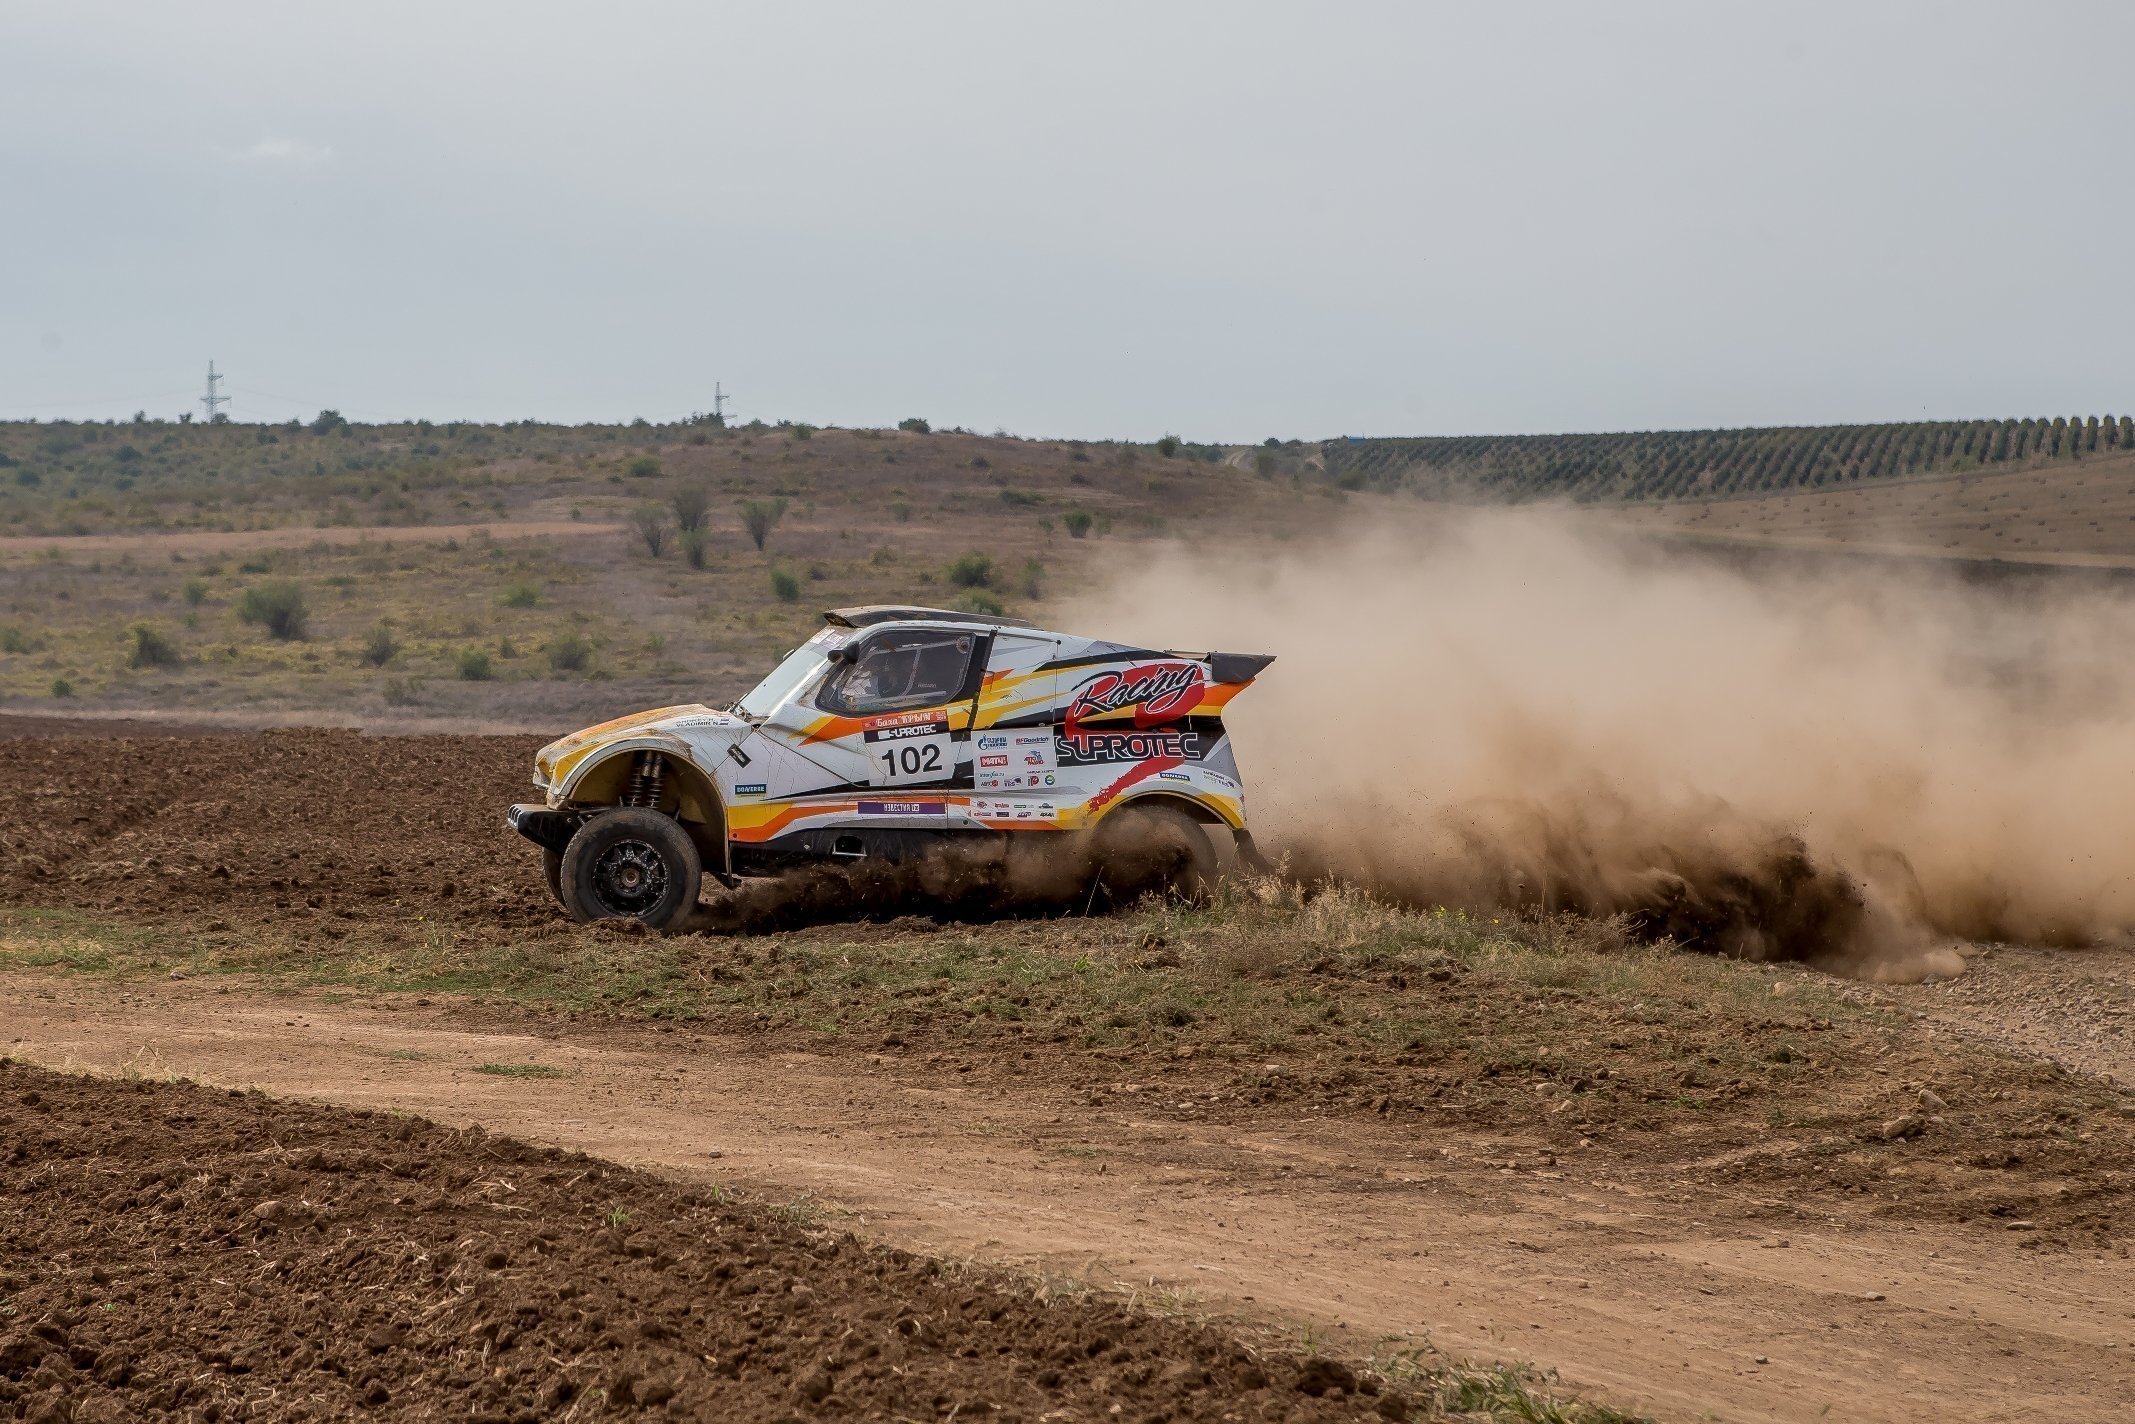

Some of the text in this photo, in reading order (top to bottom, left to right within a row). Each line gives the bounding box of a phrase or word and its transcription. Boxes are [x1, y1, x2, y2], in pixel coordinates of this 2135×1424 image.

[1071, 663, 1199, 717] Racing
[889, 724, 937, 738] SUPROTEC
[881, 743, 942, 777] 102
[1056, 732, 1201, 760] SUPROTEC
[883, 803, 911, 812] ИЗВЕСТИЯ
